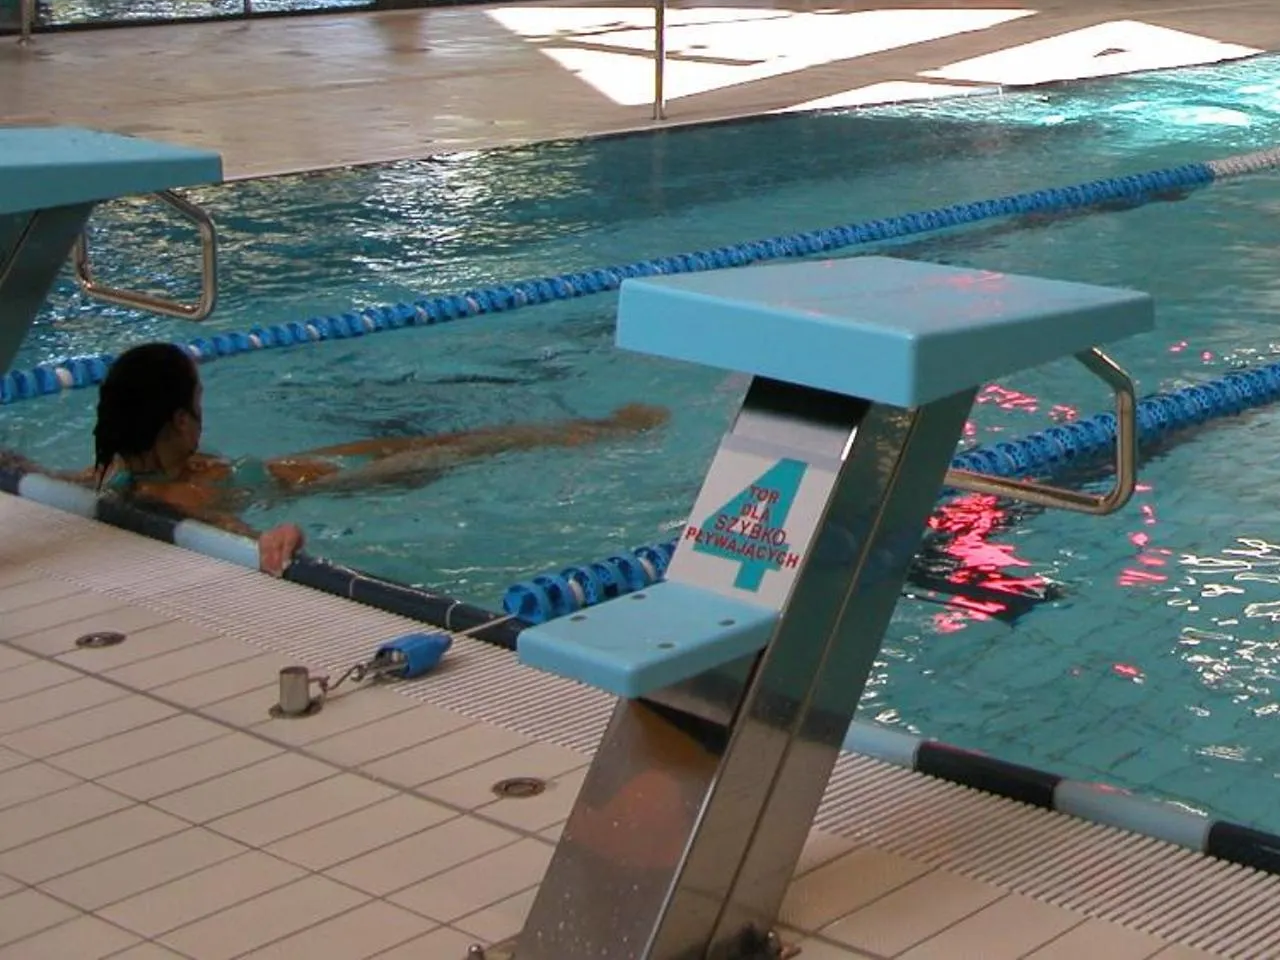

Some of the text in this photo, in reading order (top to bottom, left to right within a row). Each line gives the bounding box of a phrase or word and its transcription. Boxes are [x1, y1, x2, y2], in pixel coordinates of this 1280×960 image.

[750, 484, 781, 505] TOR
[692, 457, 809, 593] 4
[740, 503, 770, 523] DLA
[715, 514, 787, 546] SZYBKO
